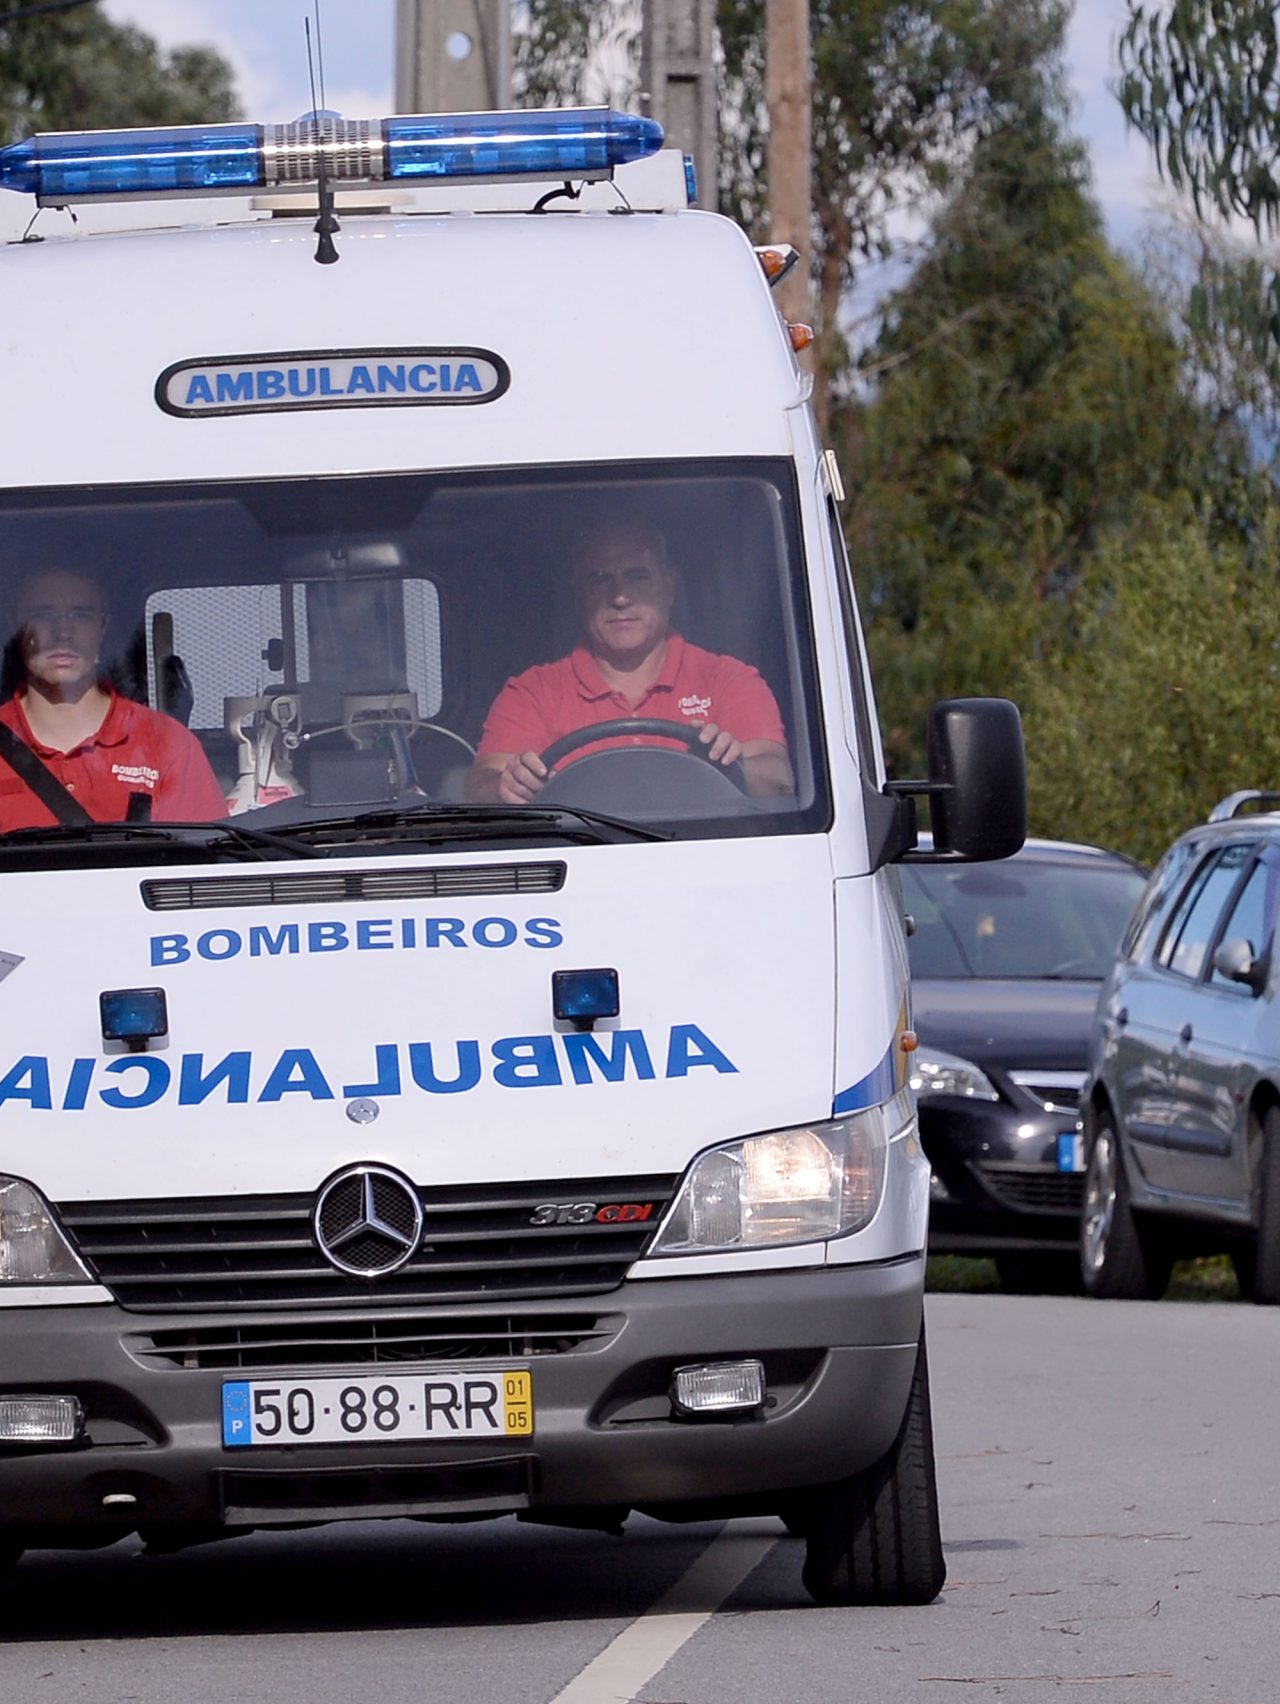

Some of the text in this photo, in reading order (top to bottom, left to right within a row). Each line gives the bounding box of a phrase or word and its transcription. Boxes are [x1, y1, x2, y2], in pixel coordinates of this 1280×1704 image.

[185, 363, 483, 405] AMBULANCIA
[150, 916, 563, 967] BOMBEIROS
[505, 1379, 524, 1397] 01
[231, 1419, 244, 1434] P
[507, 1411, 527, 1428] 05
